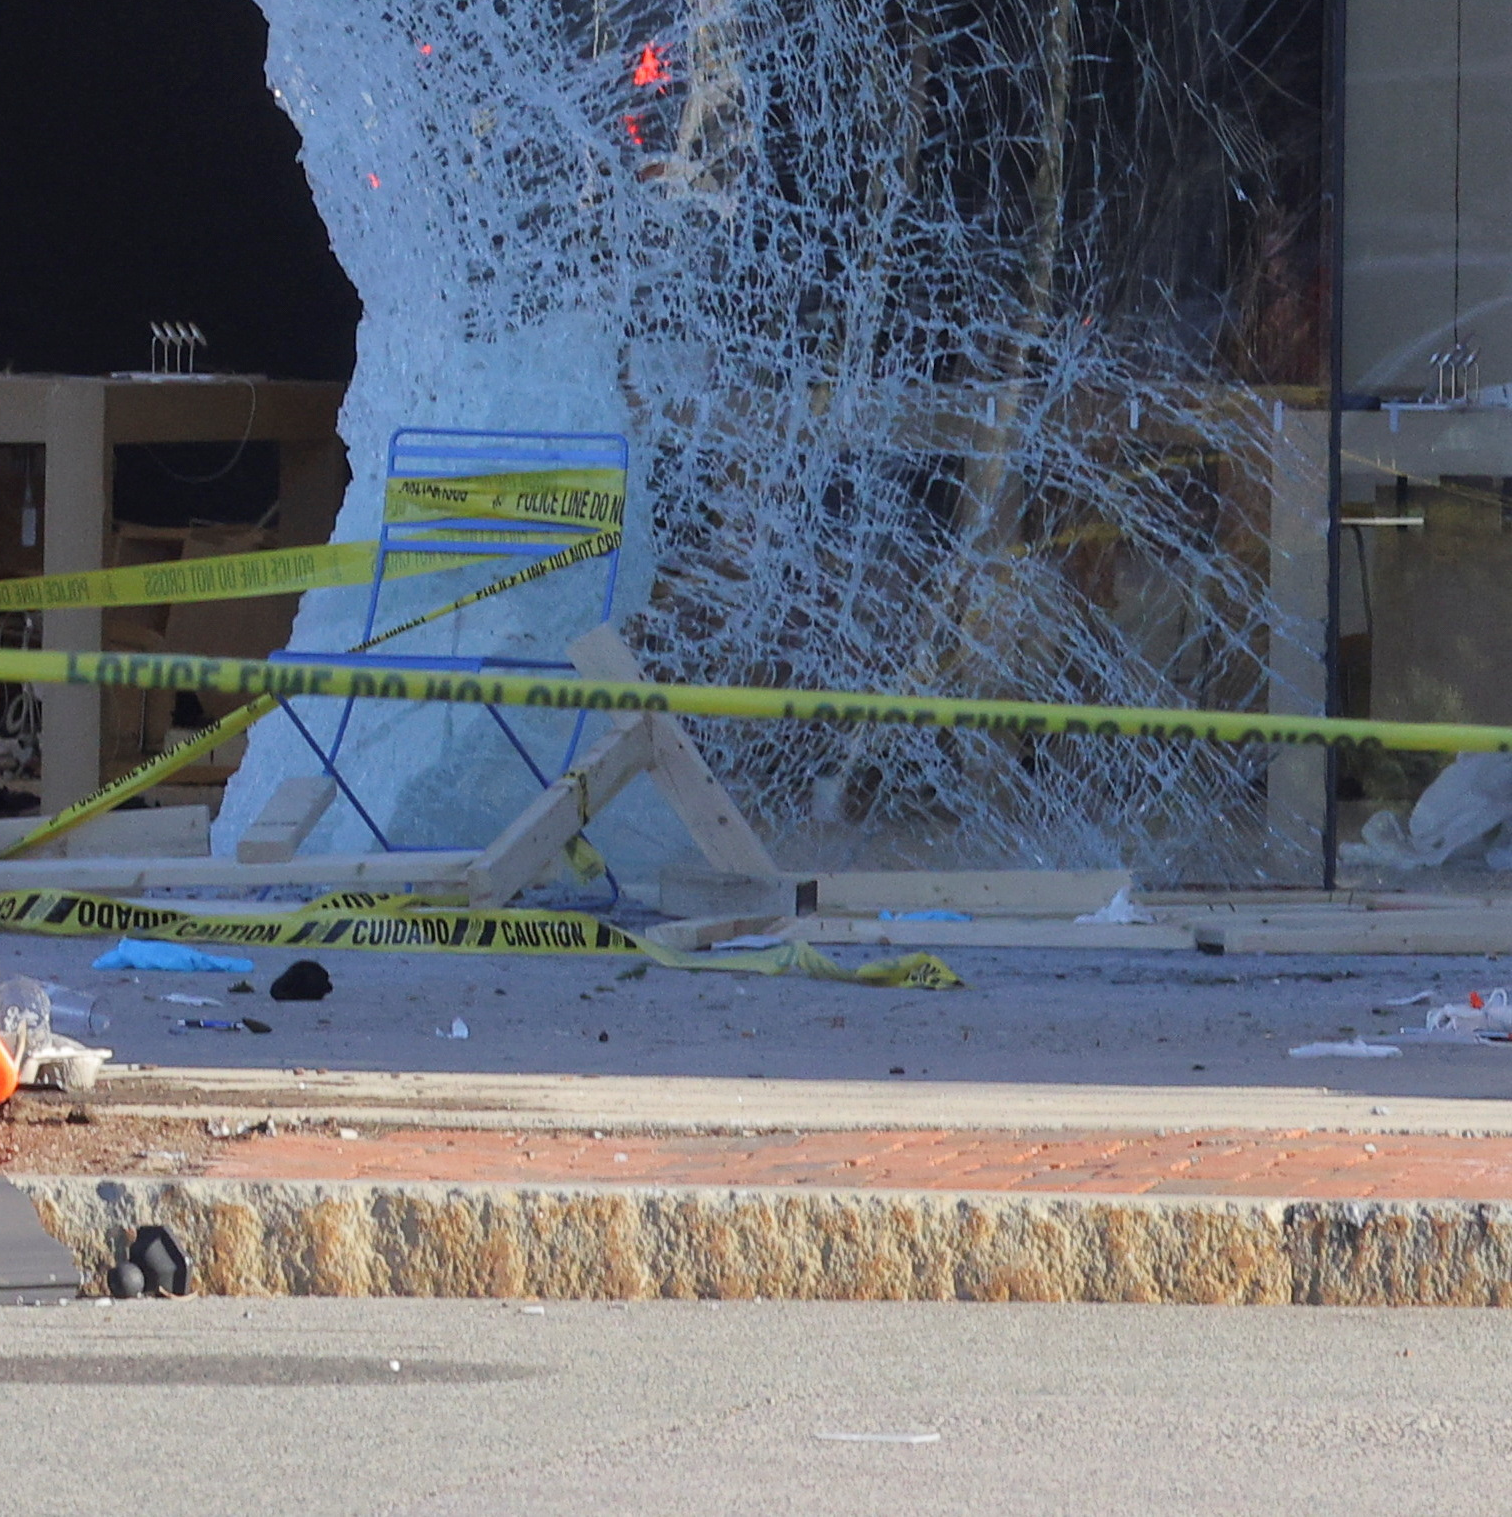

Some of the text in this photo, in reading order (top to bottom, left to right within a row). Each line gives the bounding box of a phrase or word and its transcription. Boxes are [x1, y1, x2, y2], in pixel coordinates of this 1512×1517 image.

[561, 491, 586, 519] LINE
[590, 492, 609, 520] DO
[176, 918, 587, 948] CAUTION CUIDADO CAUTION
